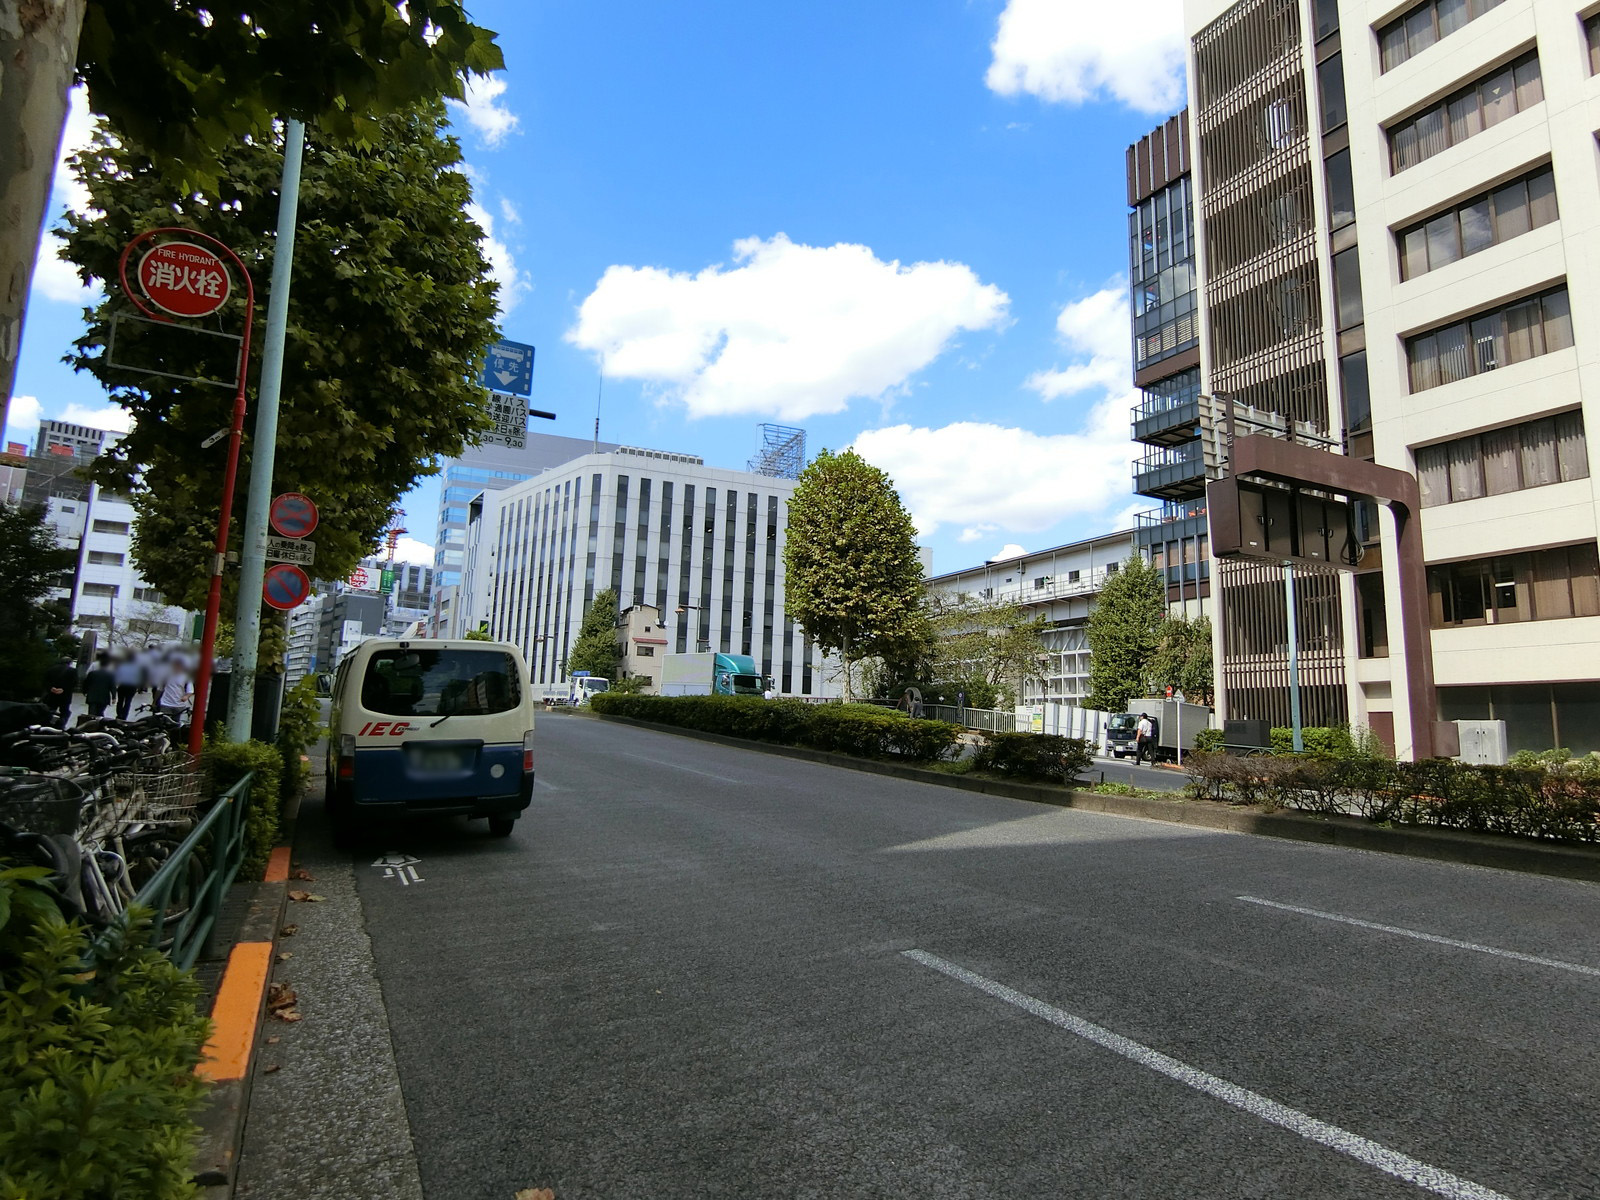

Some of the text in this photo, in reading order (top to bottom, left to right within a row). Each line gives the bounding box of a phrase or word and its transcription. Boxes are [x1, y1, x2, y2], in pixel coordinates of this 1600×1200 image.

[157, 248, 216, 266] FIRE HYDRANT
[148, 259, 223, 299] 消火栓
[493, 358, 520, 373] 優先
[486, 394, 525, 408] 線バス
